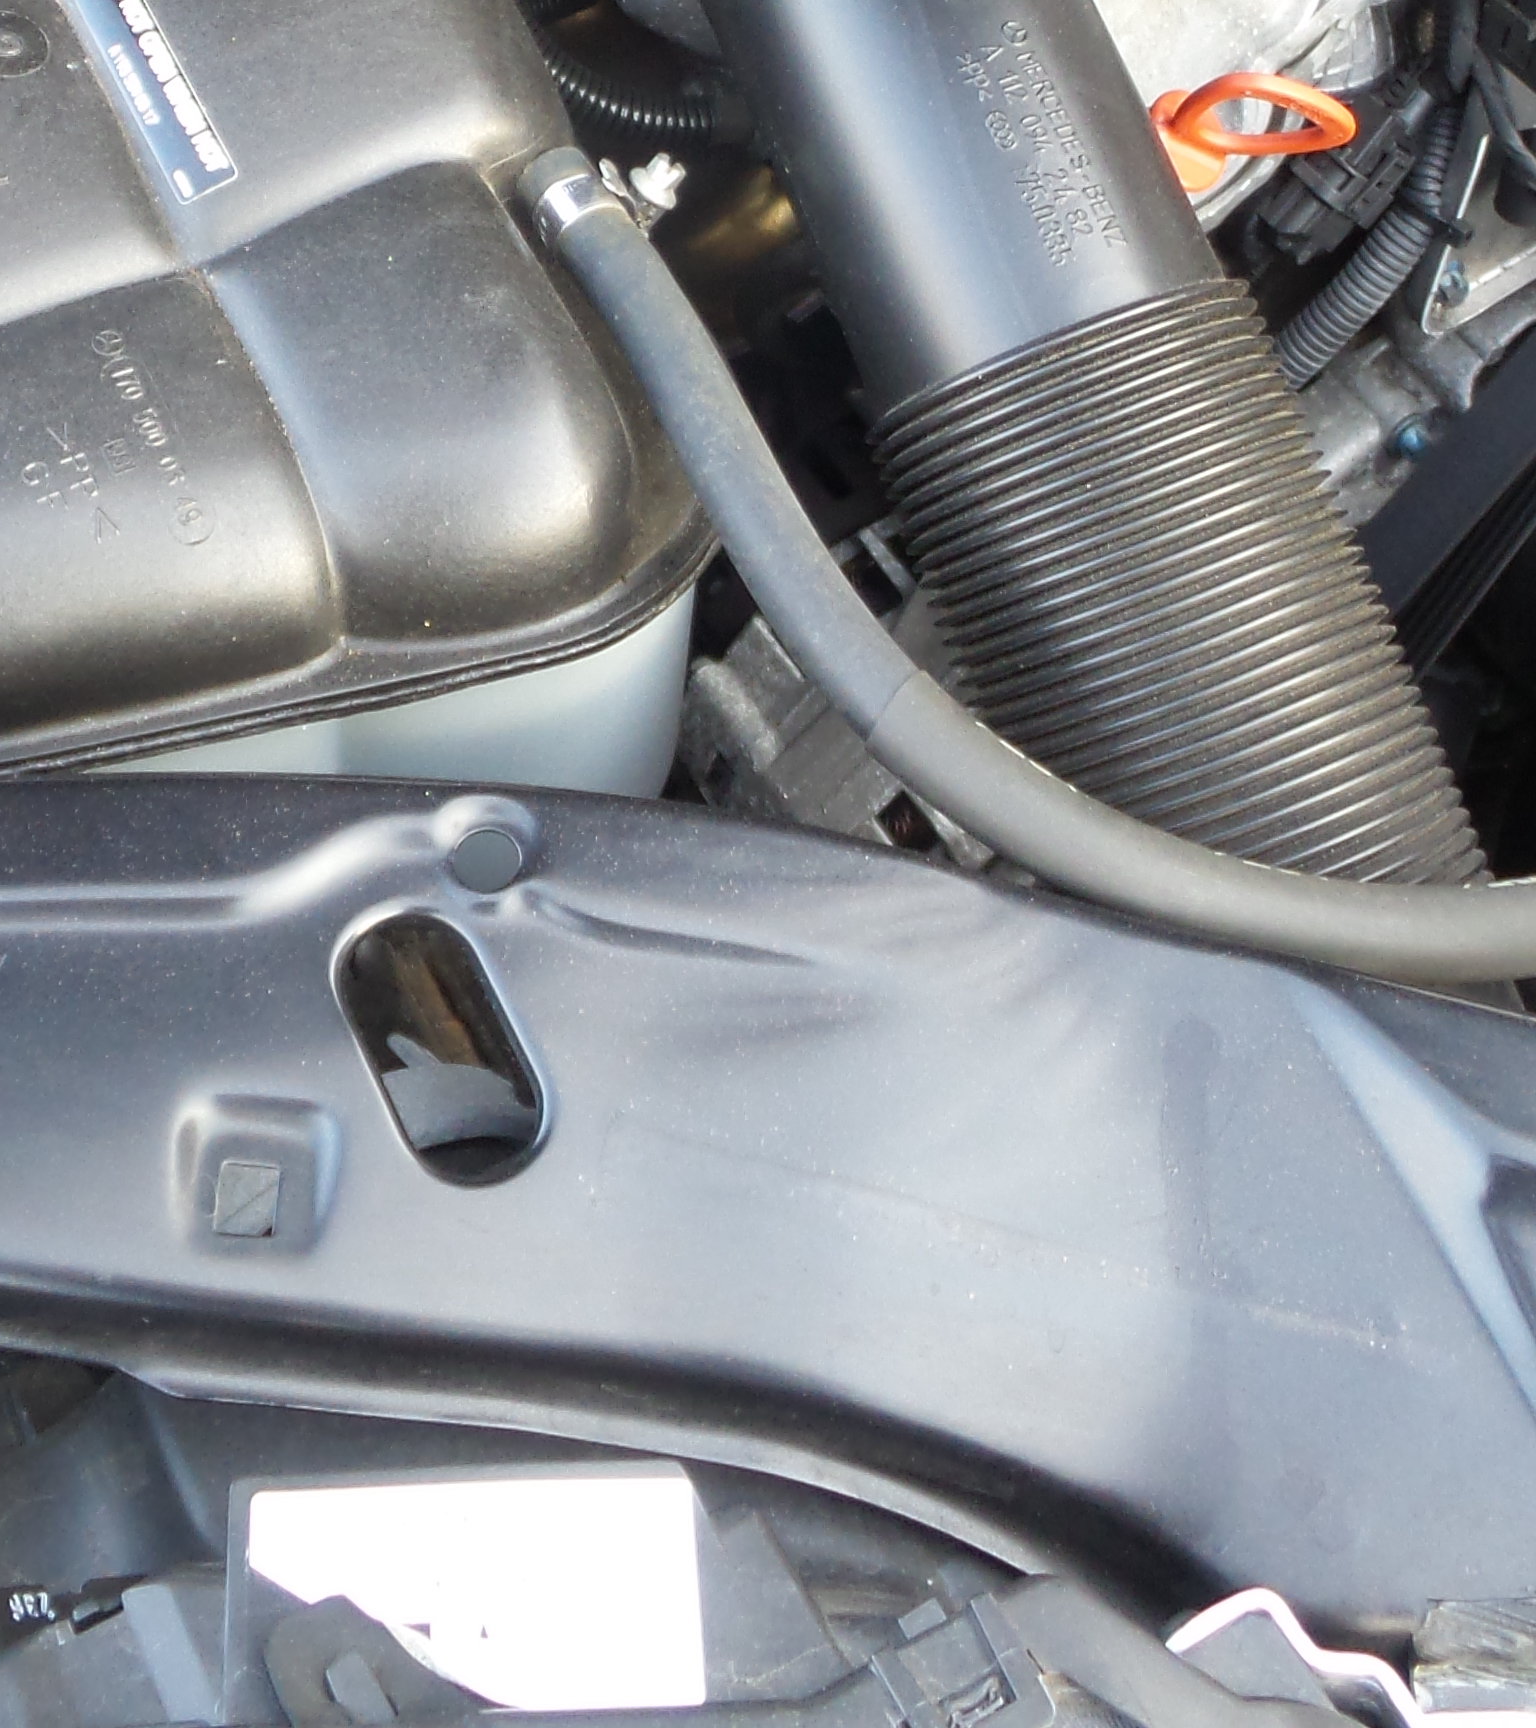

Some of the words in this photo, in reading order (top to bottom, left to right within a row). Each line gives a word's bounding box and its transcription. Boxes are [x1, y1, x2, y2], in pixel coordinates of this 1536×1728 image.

[137, 29, 179, 83] OPEN
[163, 75, 208, 135] WHEN
[190, 129, 230, 173] HOT
[1015, 49, 1129, 248] MERCEDES-BENZ
